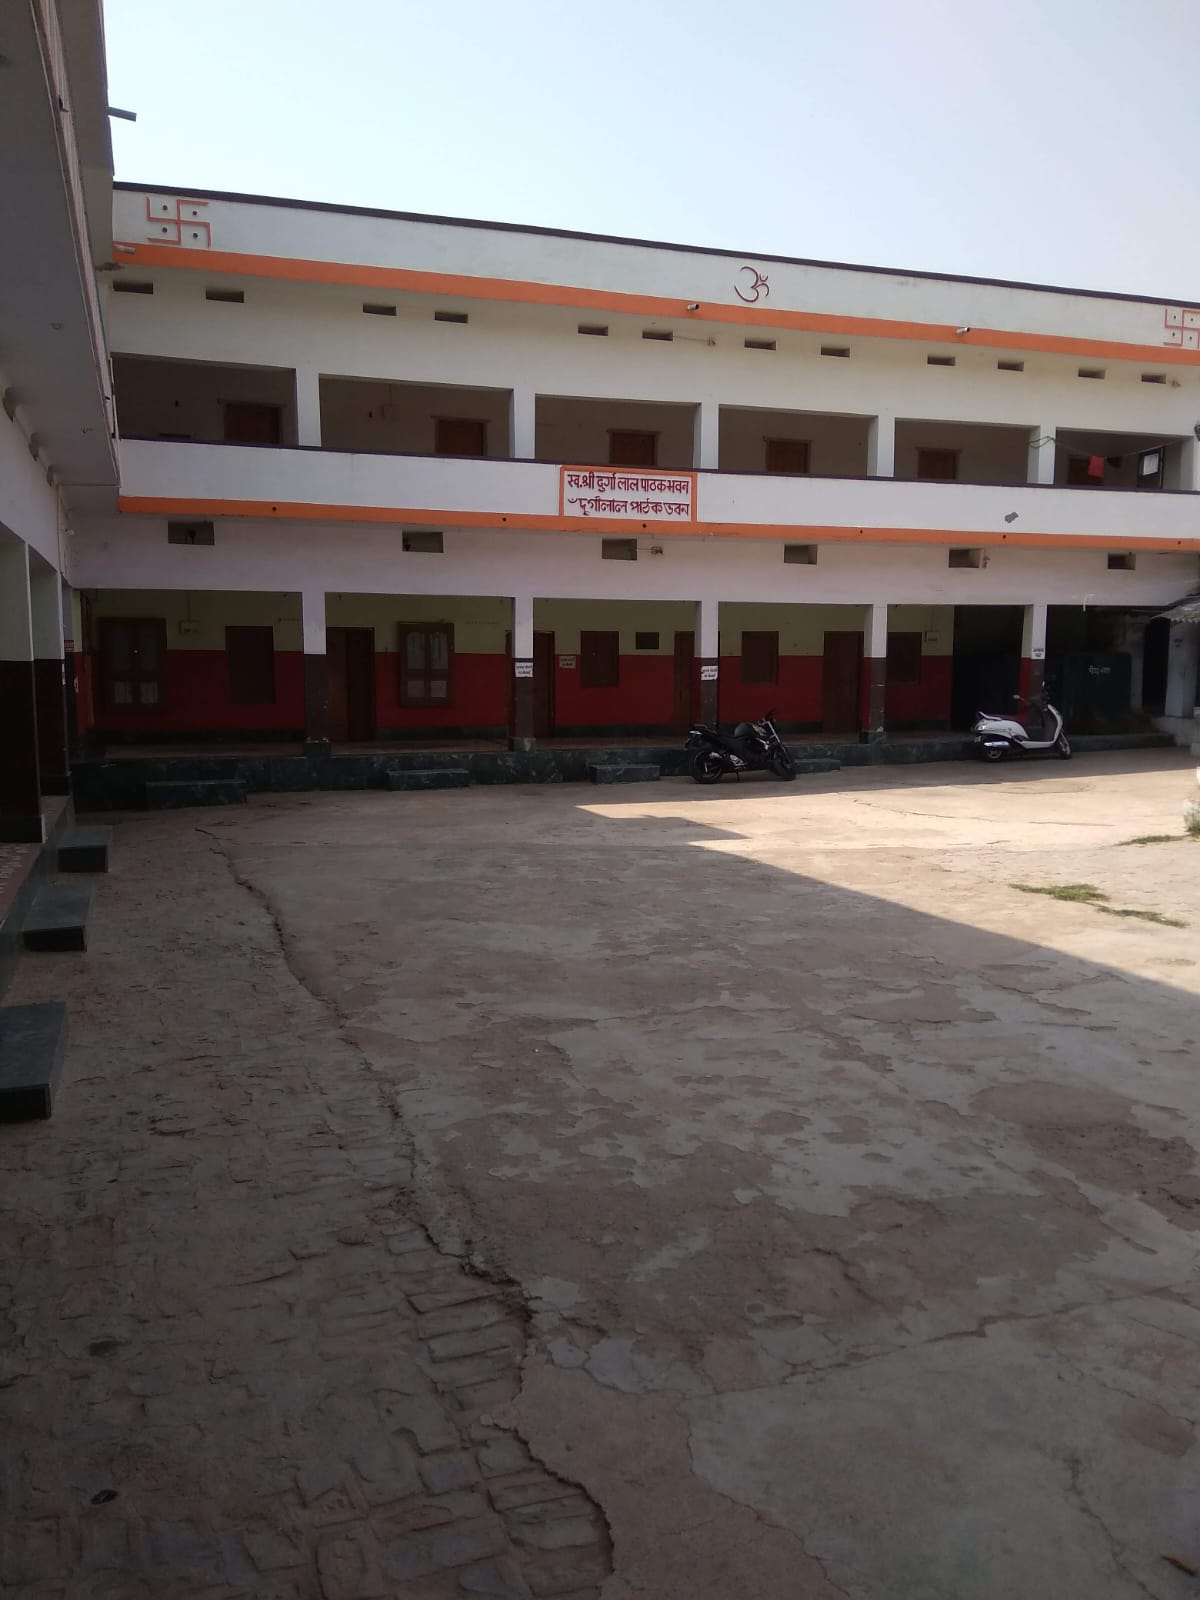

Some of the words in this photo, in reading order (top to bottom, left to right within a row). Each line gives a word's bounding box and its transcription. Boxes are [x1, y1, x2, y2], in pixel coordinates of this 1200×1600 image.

[596, 472, 616, 492] दुर्गा
[617, 477, 639, 492] लाल
[640, 478, 666, 493] पाठक
[666, 479, 689, 495] भवन
[629, 497, 663, 515] পাঠক
[663, 502, 690, 516] ভবন
